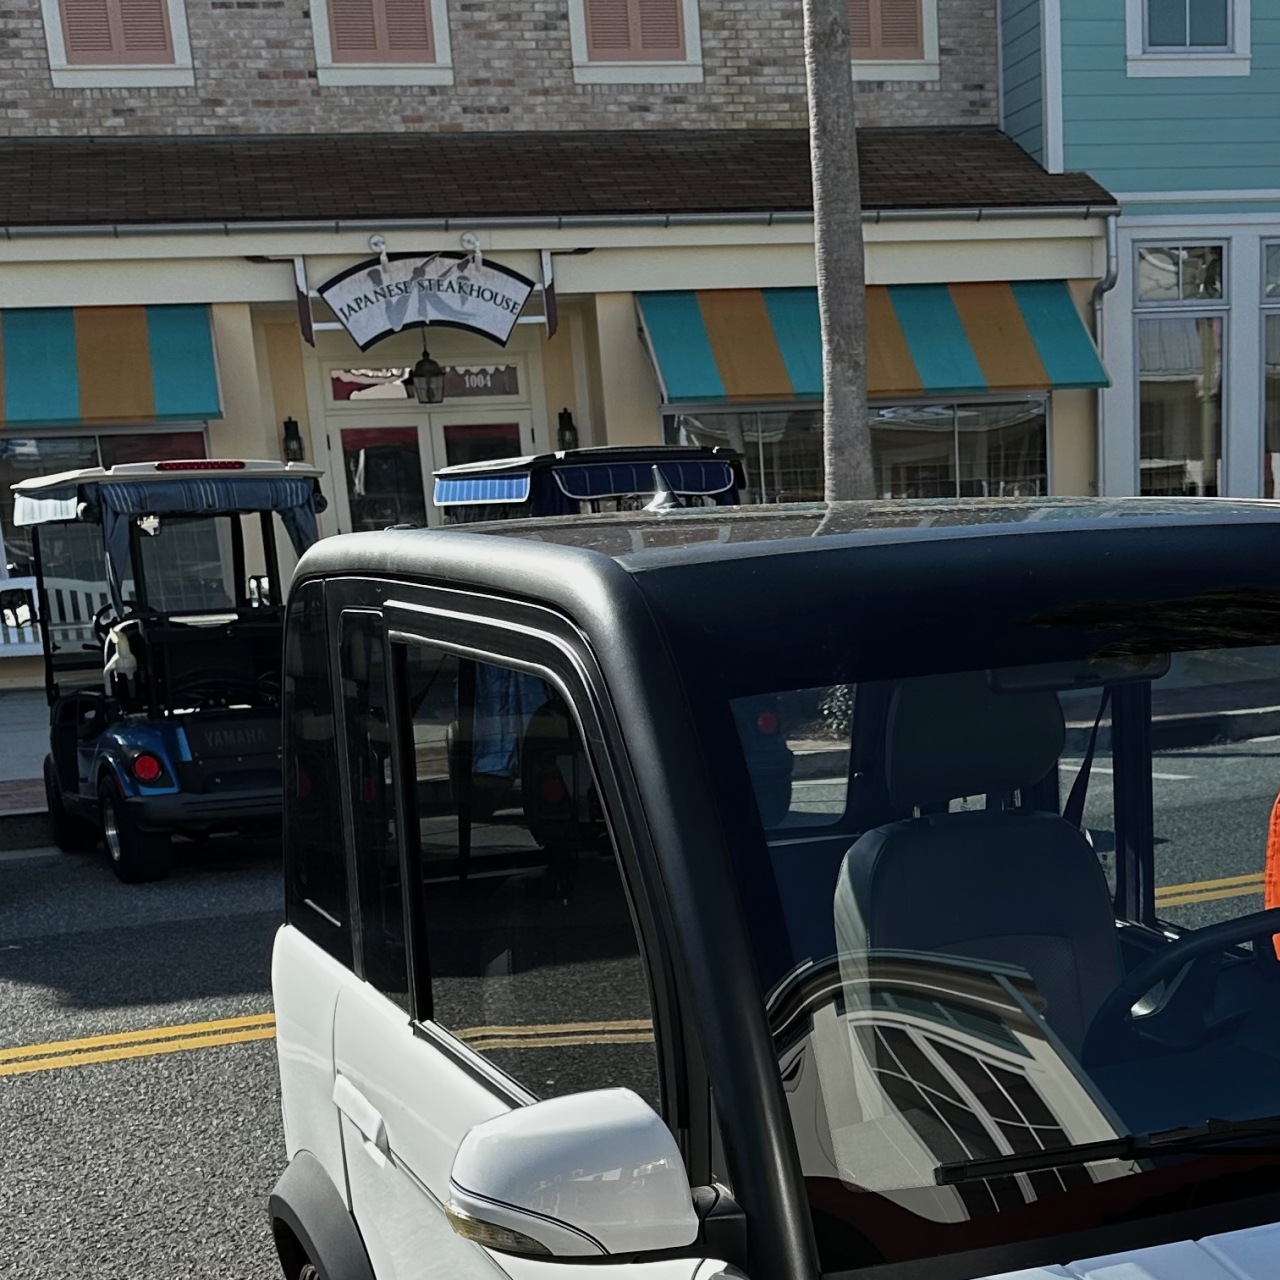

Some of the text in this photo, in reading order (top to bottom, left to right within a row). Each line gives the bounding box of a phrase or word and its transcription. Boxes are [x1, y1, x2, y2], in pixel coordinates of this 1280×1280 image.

[339, 278, 521, 324] JAPANESE STEAKHOUSE
[464, 374, 492, 388] 1004
[203, 727, 267, 747] YAMAHA
